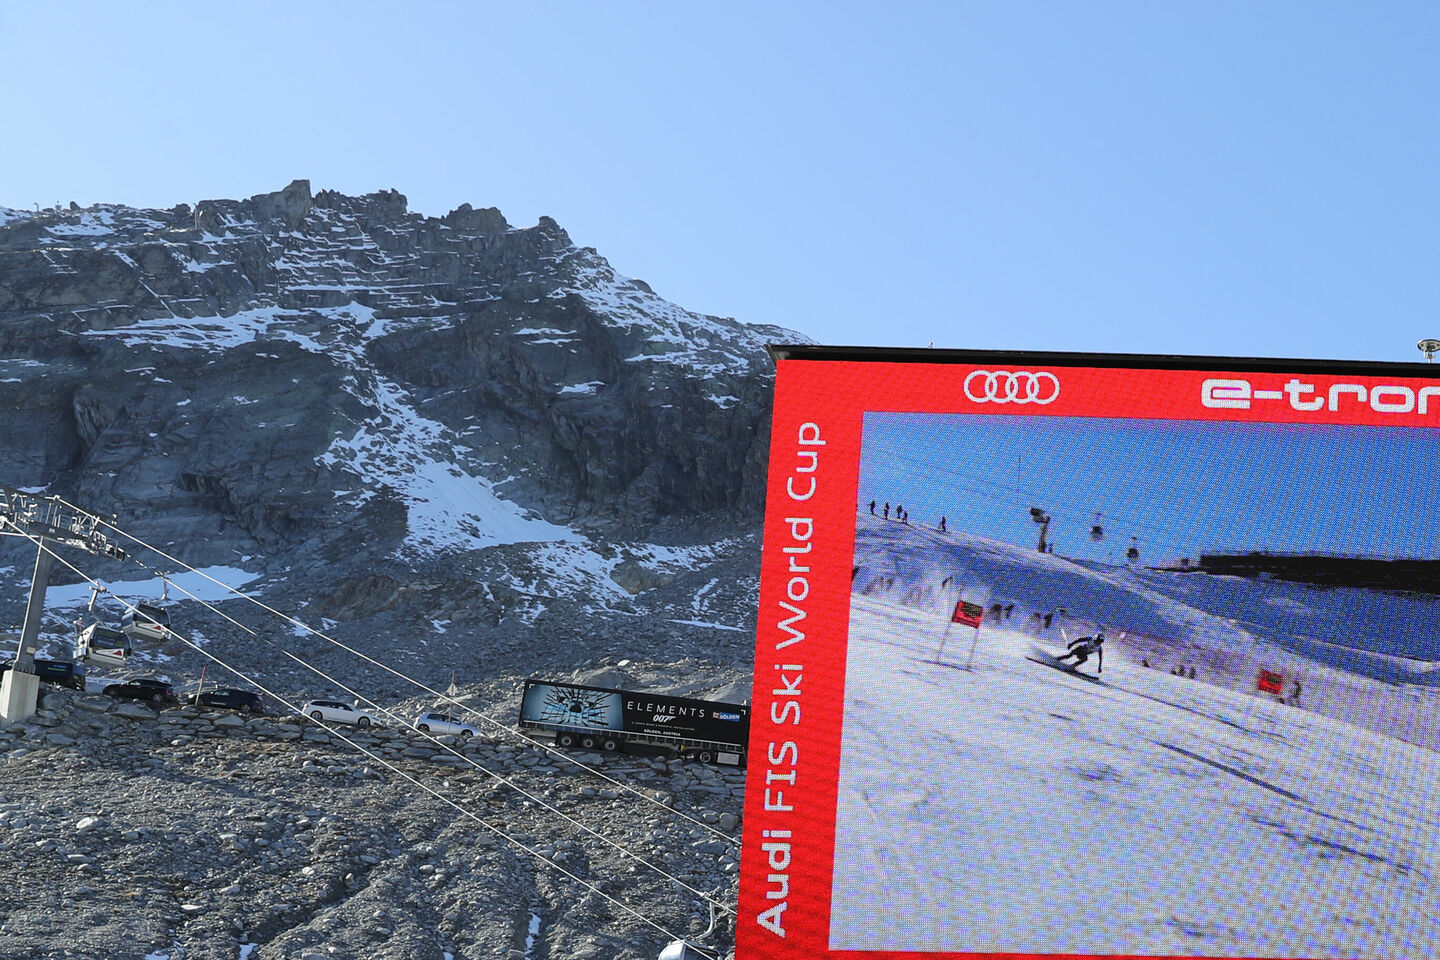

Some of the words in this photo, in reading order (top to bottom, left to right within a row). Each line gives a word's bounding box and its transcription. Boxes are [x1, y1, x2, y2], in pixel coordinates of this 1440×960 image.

[786, 421, 827, 501] Cup
[775, 517, 814, 650] World
[626, 701, 705, 718] ELEMENTS
[652, 714, 676, 722] 007
[770, 664, 804, 725] Ski
[764, 740, 798, 812] FIS
[756, 829, 792, 938] Audi
